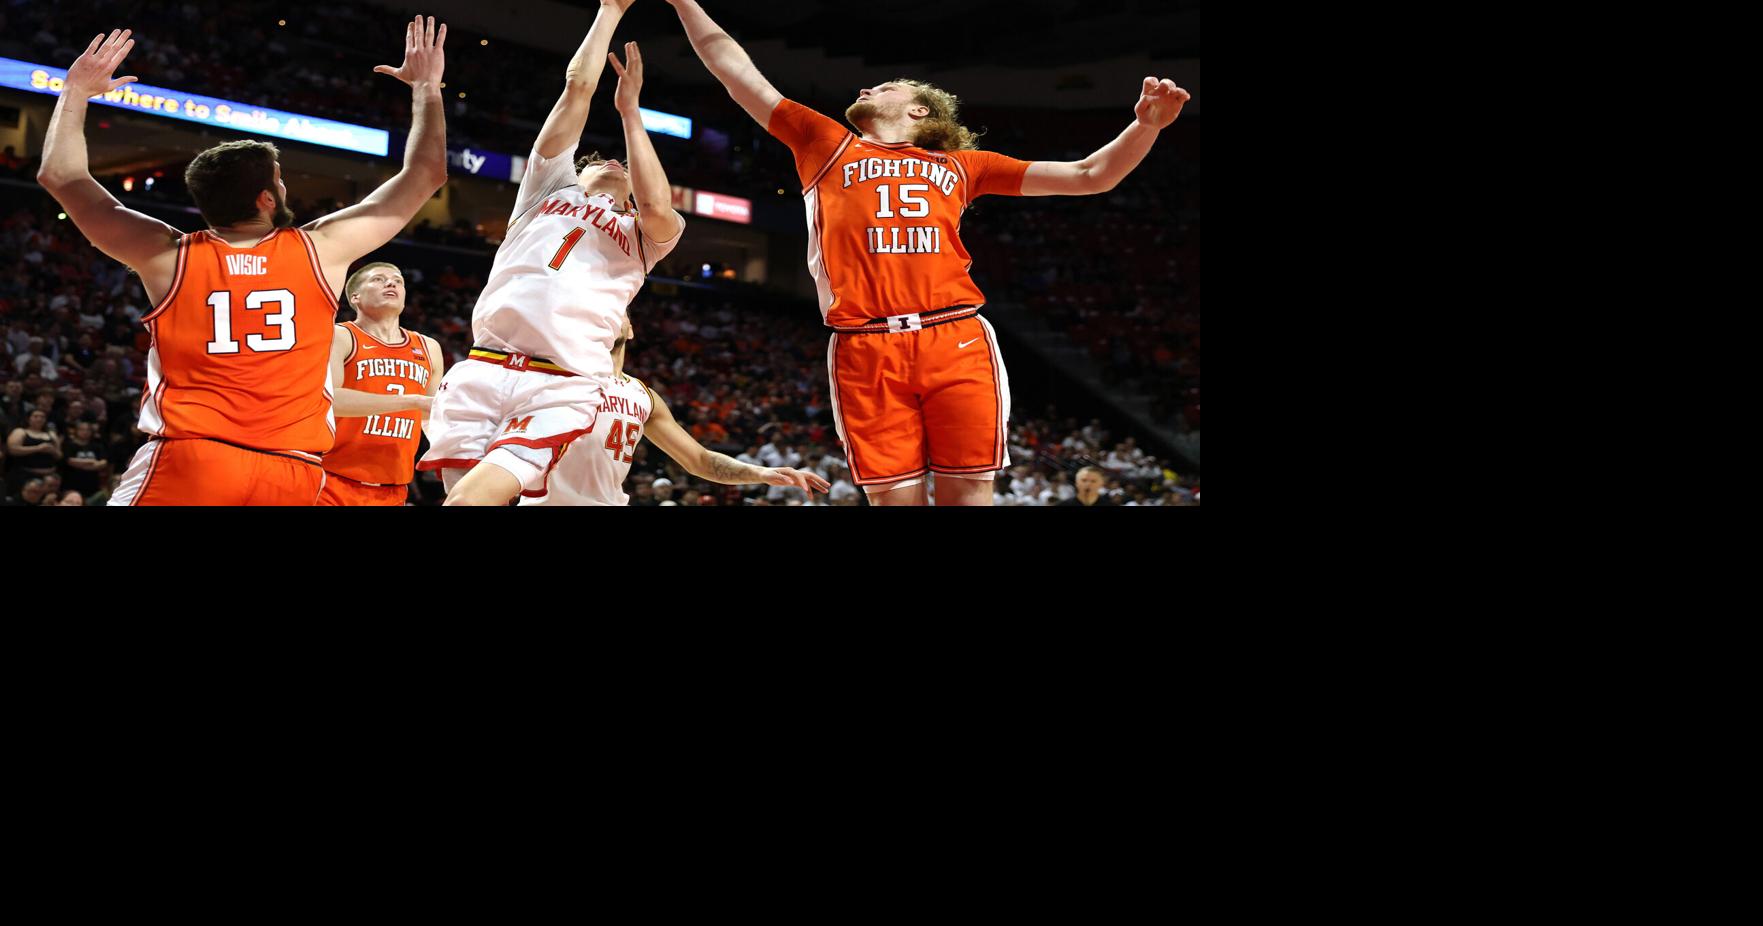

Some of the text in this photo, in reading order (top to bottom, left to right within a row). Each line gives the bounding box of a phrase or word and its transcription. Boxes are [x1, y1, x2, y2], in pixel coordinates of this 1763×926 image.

[30, 69, 180, 113] Sowhere
[184, 98, 211, 119] to
[842, 157, 959, 197] FIGHTING
[875, 184, 930, 218] 15
[536, 198, 631, 257] MARYLAND
[866, 226, 941, 254] ILLINI
[225, 253, 268, 276] IVISIC
[548, 226, 587, 271] 1
[206, 288, 297, 354] 13
[355, 358, 430, 390] FIGHTING
[508, 353, 526, 368] M
[502, 415, 535, 434] M
[600, 394, 647, 425] ARYLAN
[363, 415, 415, 440] ILLINI
[605, 418, 640, 464] 45
